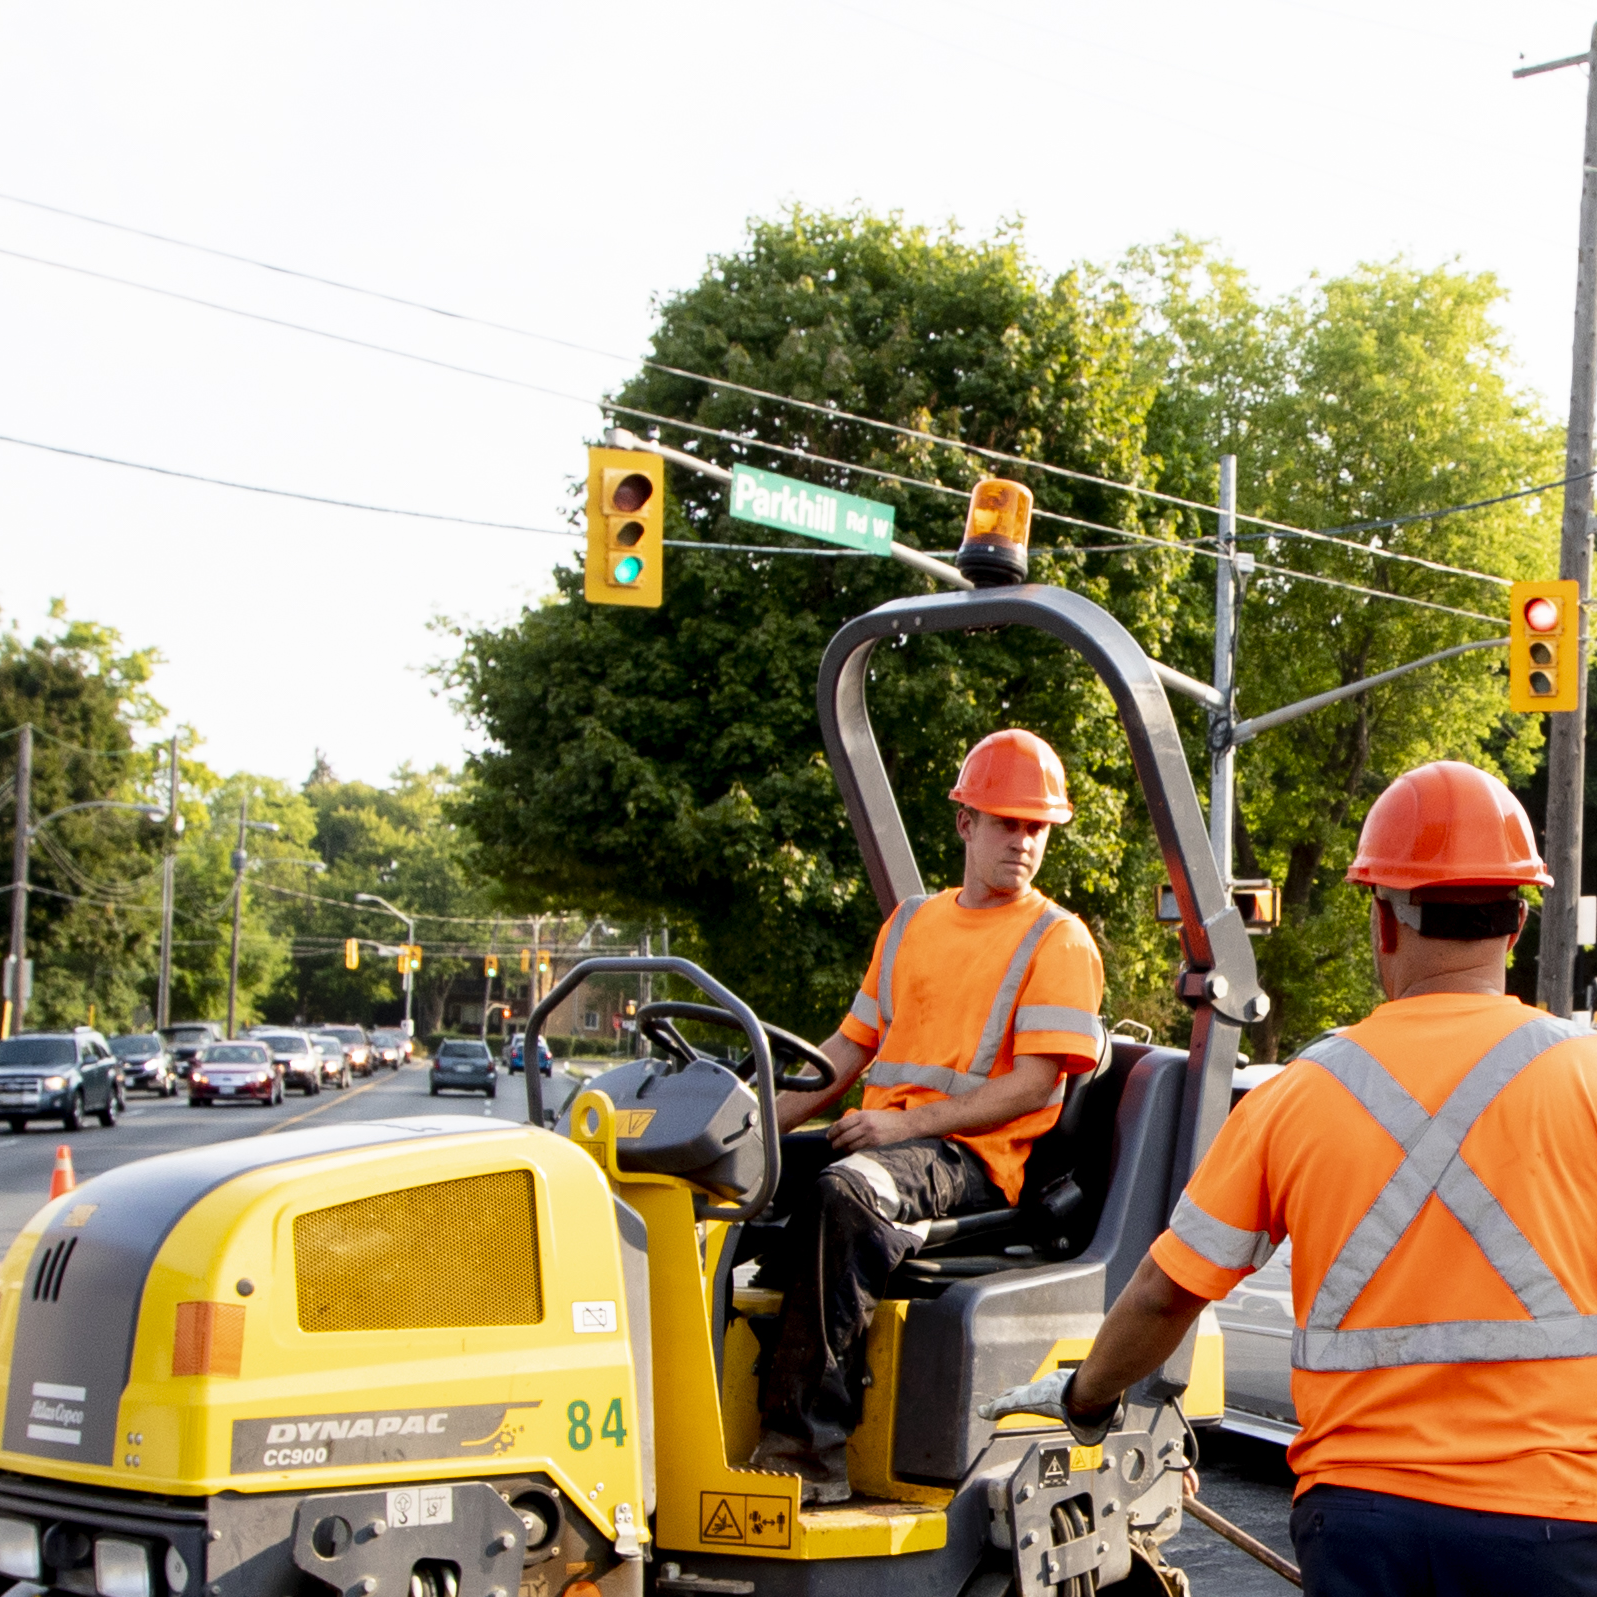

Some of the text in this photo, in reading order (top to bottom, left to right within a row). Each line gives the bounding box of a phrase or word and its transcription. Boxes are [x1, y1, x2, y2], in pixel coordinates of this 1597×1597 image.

[735, 472, 890, 539] Parkhill Rd W
[265, 1412, 449, 1445] DYNAPAC
[566, 1397, 628, 1451] 84
[262, 1446, 328, 1467] CC900
